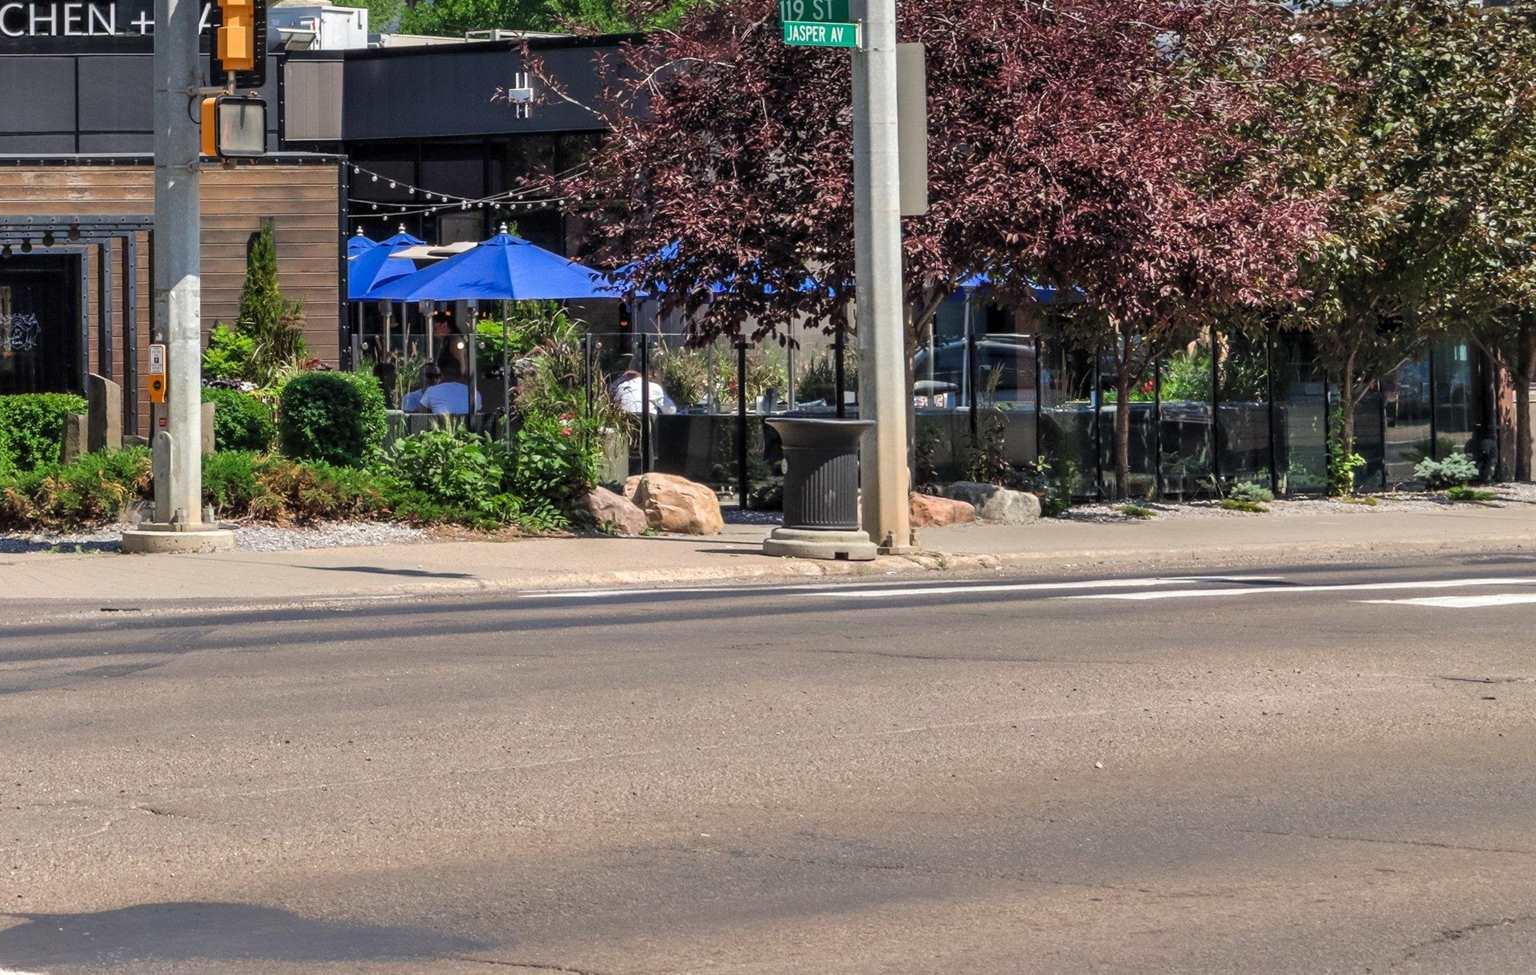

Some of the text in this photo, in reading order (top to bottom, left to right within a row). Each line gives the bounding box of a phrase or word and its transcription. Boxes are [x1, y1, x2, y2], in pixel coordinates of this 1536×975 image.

[779, 0, 804, 22] 119
[786, 25, 844, 43] JASPER AV
